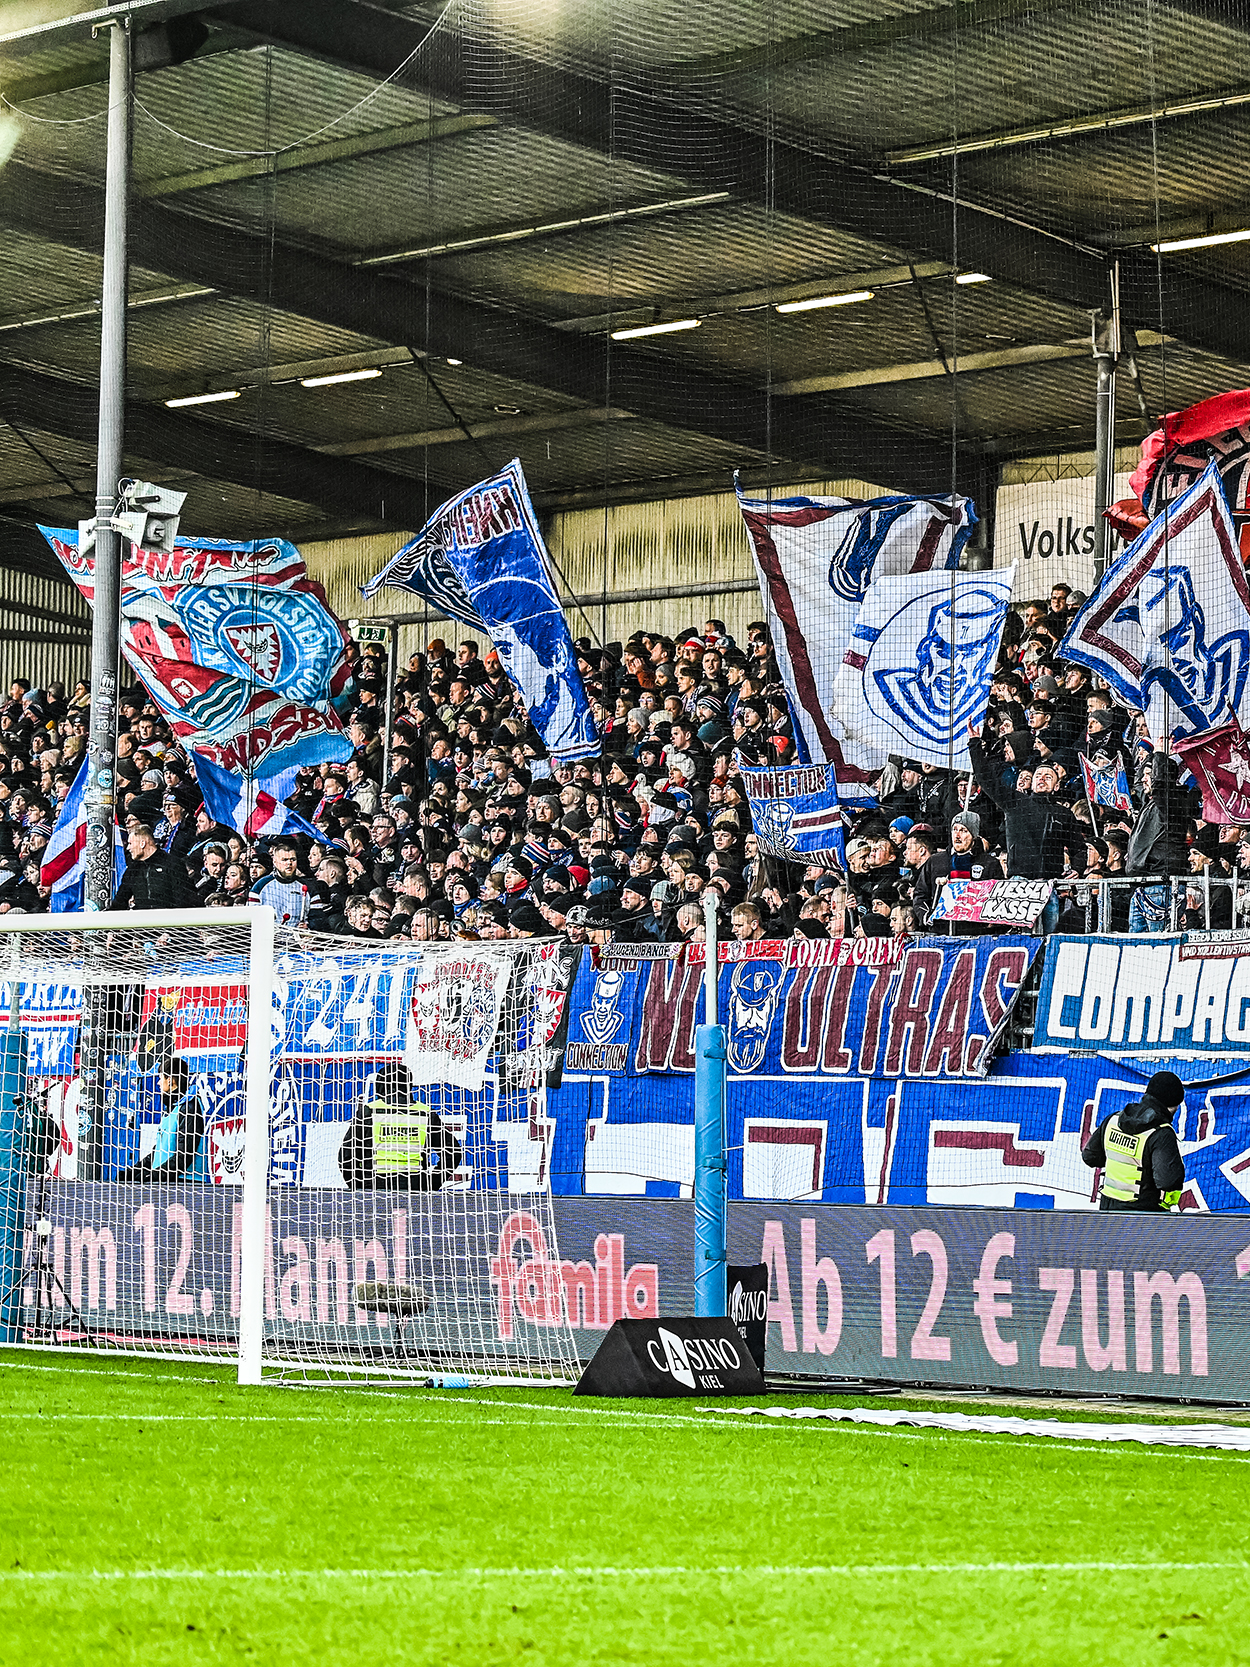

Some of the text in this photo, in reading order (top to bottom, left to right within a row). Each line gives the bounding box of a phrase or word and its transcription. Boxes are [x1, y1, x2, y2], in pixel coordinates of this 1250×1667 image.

[740, 766, 827, 800] ONNECTION
[787, 936, 904, 968] LOYAL CREW
[565, 1042, 629, 1071] CONNECTION
[133, 1203, 213, 1317] 12.
[761, 1218, 843, 1357] Ab
[865, 1229, 951, 1361] 12
[973, 1231, 1018, 1367] €
[1038, 1267, 1209, 1377] zum
[729, 1289, 767, 1323] ASINO
[646, 1336, 741, 1373] CASINO
[698, 1374, 725, 1390] KIEL
